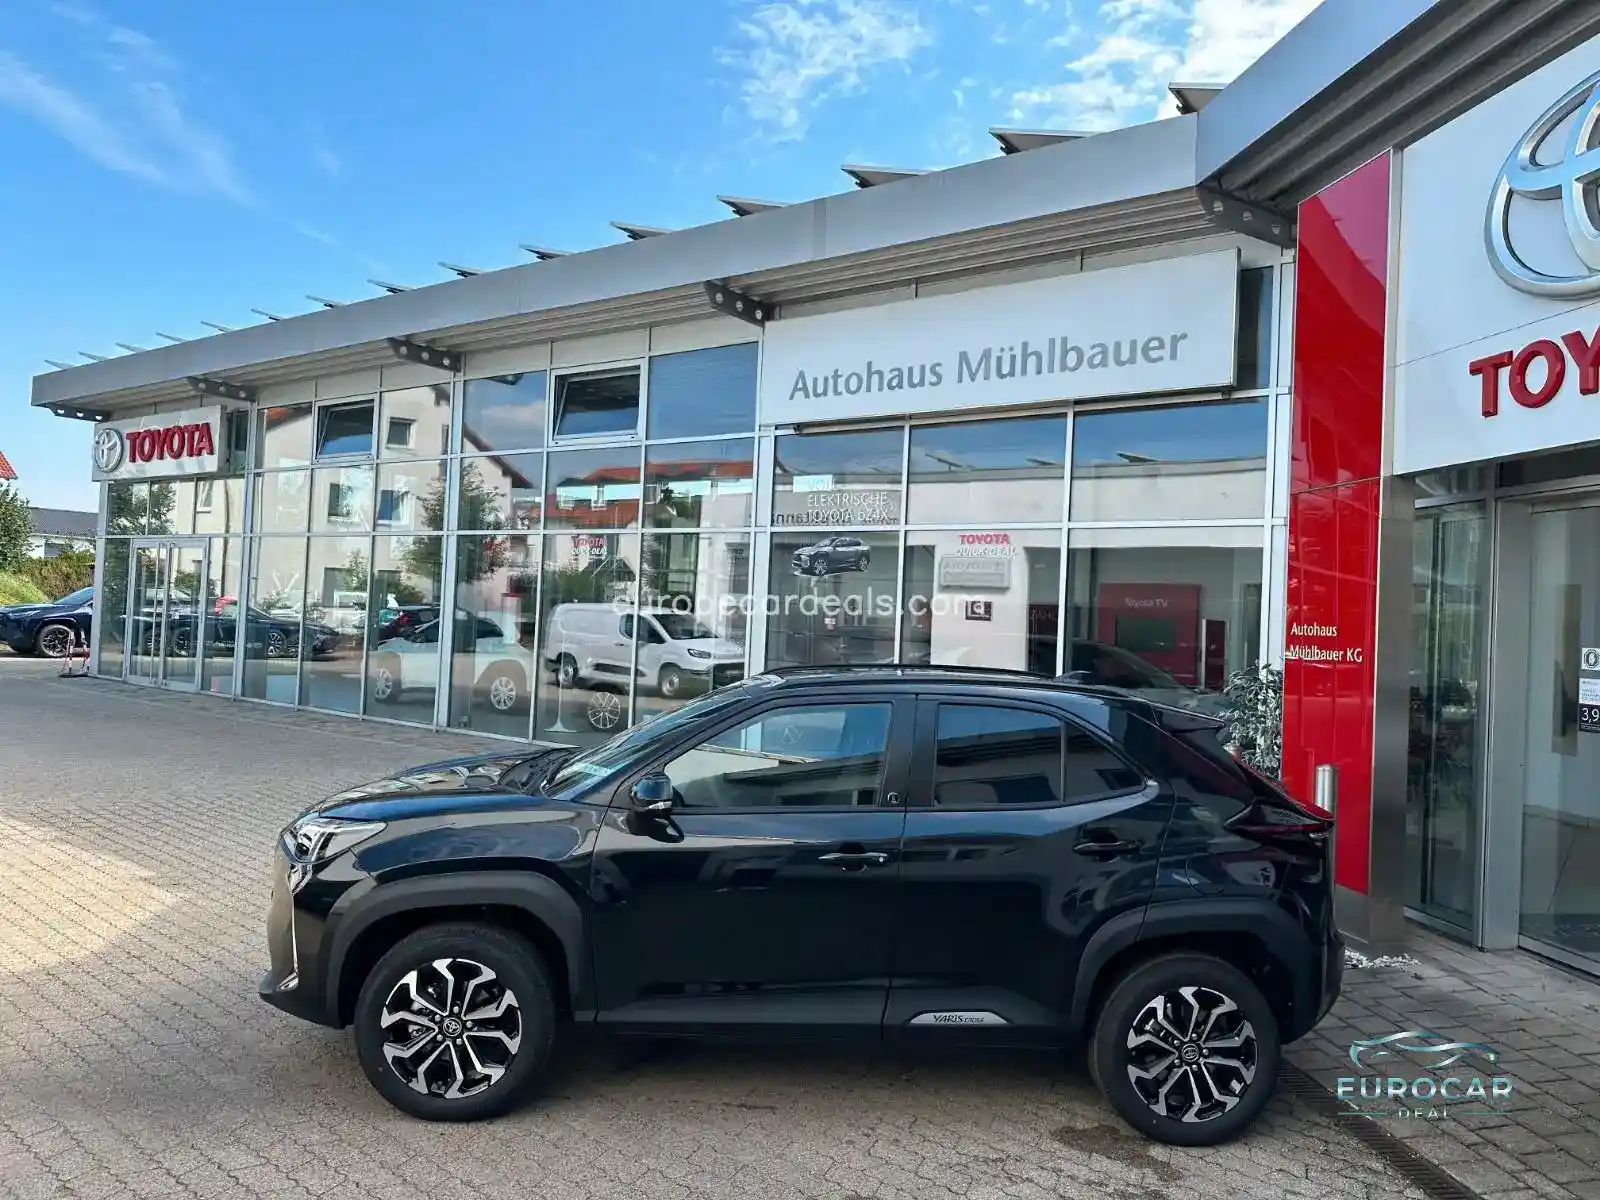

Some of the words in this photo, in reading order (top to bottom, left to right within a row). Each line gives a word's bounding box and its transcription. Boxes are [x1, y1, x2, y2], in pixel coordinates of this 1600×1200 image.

[789, 361, 942, 401] Autohaus
[956, 332, 1188, 384] Mühlbauer
[126, 422, 214, 463] TOYOTA
[808, 492, 888, 507] ELEKTRISCHE
[808, 508, 853, 521] TOYOTA
[959, 533, 1010, 545] TOYOTA
[1290, 622, 1337, 637] Autohaus
[1289, 644, 1344, 661] Mühlbauer
[1346, 648, 1363, 662] KG
